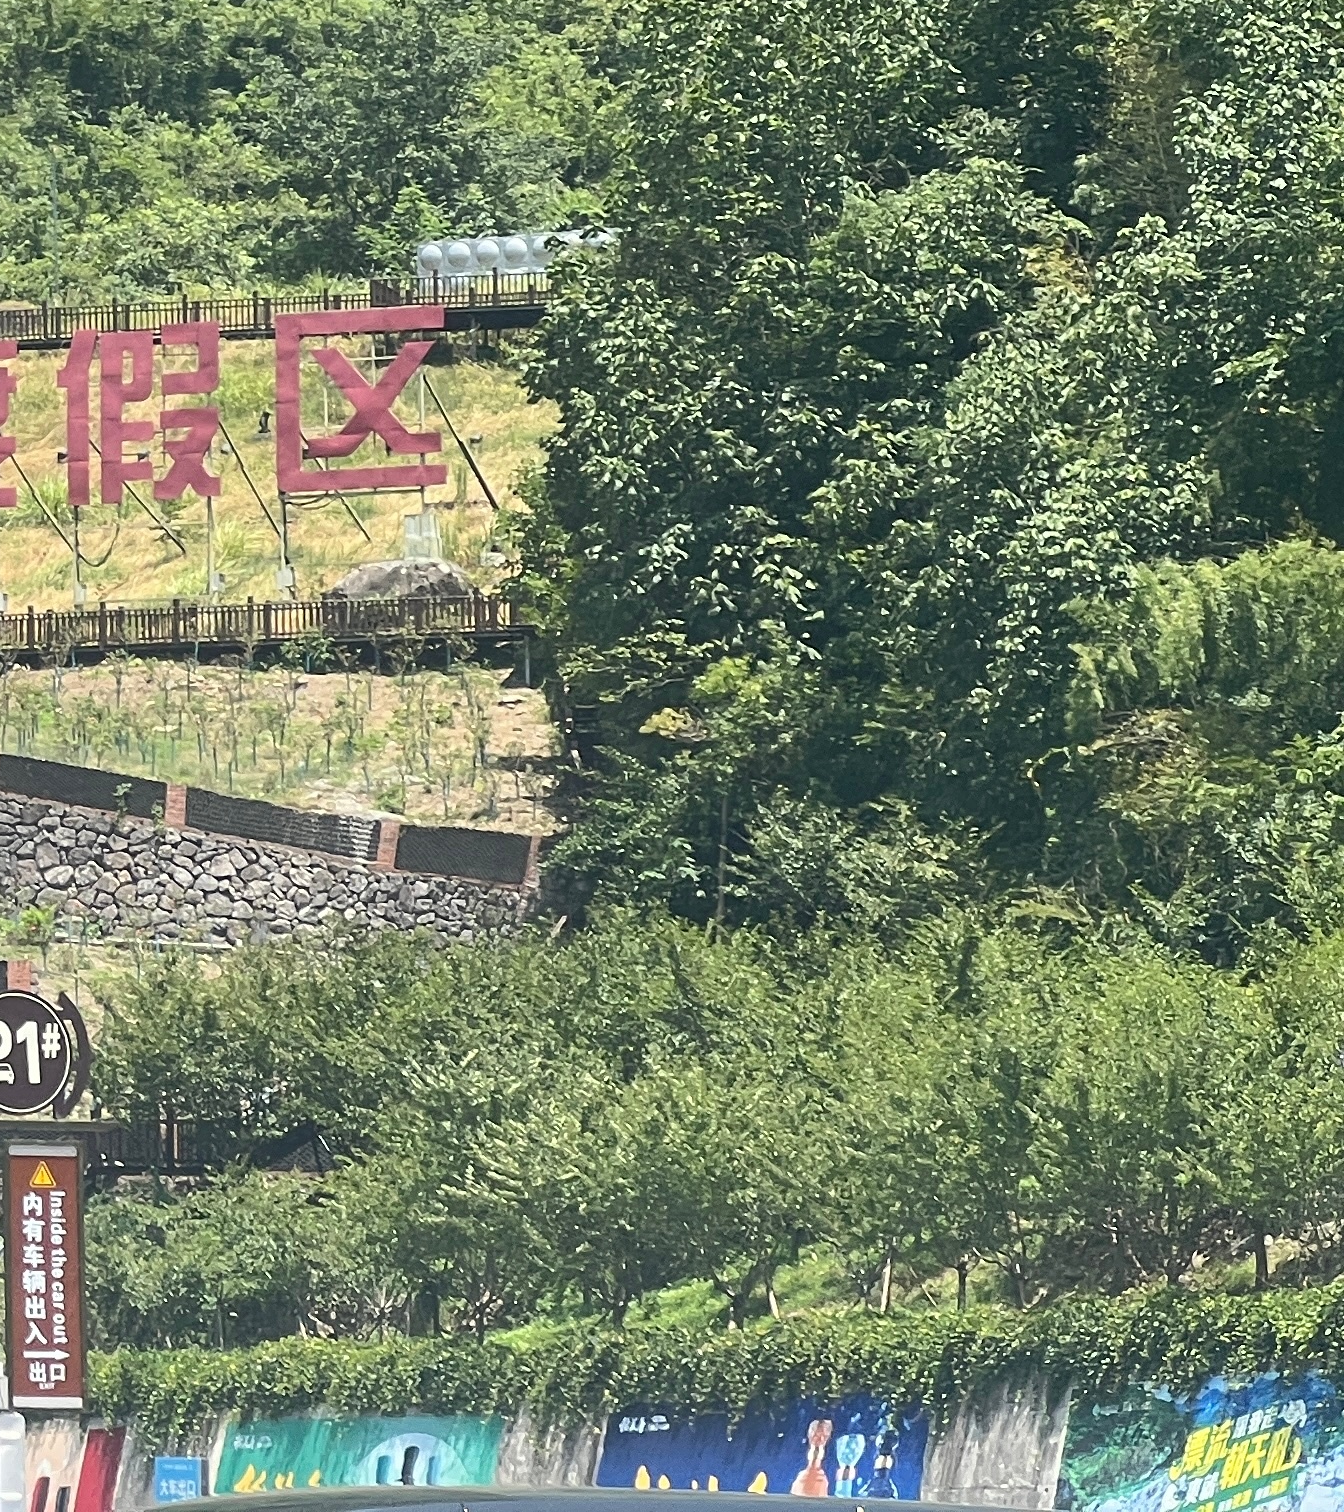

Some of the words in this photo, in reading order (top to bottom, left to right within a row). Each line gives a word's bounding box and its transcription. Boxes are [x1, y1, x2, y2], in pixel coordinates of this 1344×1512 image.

[50, 1191, 67, 1245] Inside
[22, 1191, 48, 1345] 内有车辆出入
[51, 1247, 68, 1279] the
[52, 1281, 65, 1311] car
[53, 1313, 68, 1344] out
[29, 1361, 66, 1383] 出口
